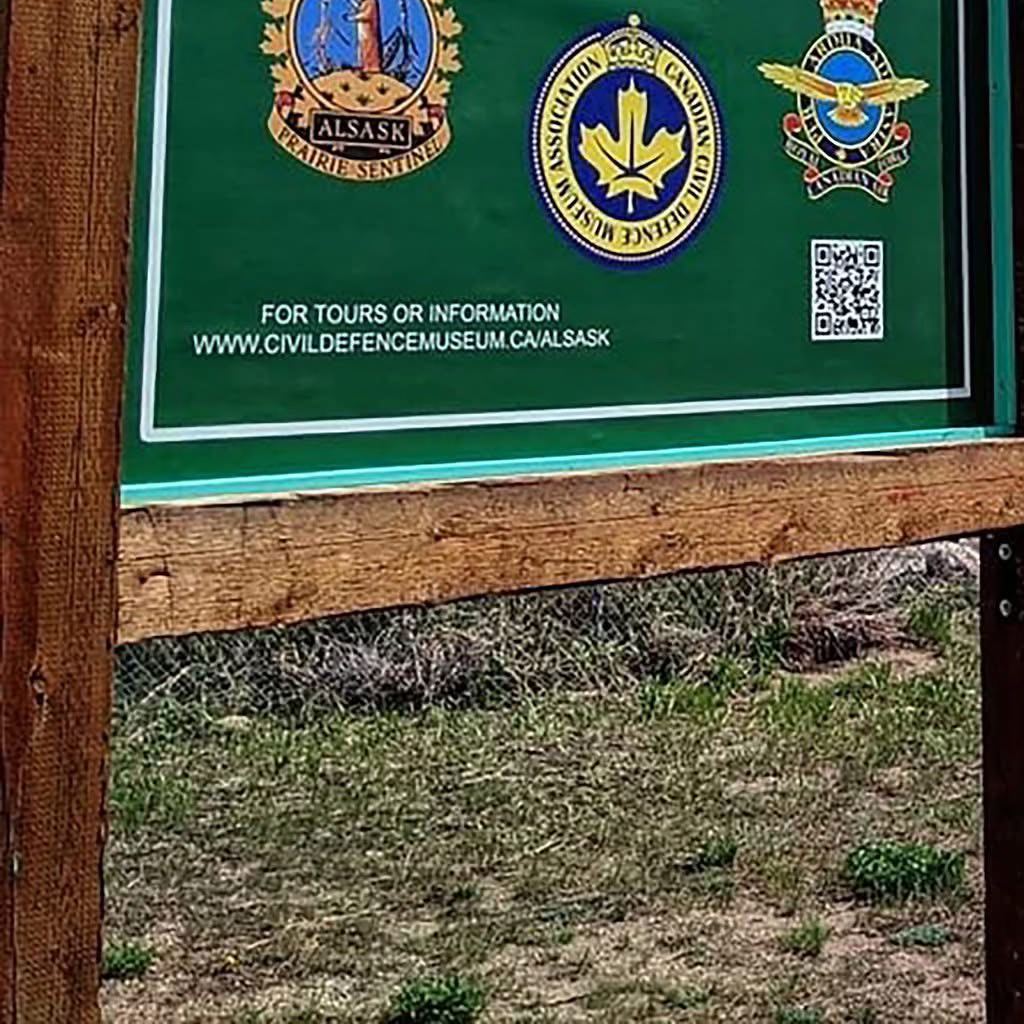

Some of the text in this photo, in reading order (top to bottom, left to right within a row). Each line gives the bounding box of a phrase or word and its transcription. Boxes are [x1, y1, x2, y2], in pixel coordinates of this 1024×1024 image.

[318, 118, 405, 142] ALSASK
[277, 127, 443, 178] PRAIRIE SENTINEL
[546, 55, 711, 246] CANADIAN CIVIL DEFENCE MUSEUM ASSOCIATION
[261, 302, 560, 325] FOR TOURS OR INFORMATION
[193, 328, 611, 355] WWW.CIVILDEFENCEMUSEUM.CA/ALSASK
